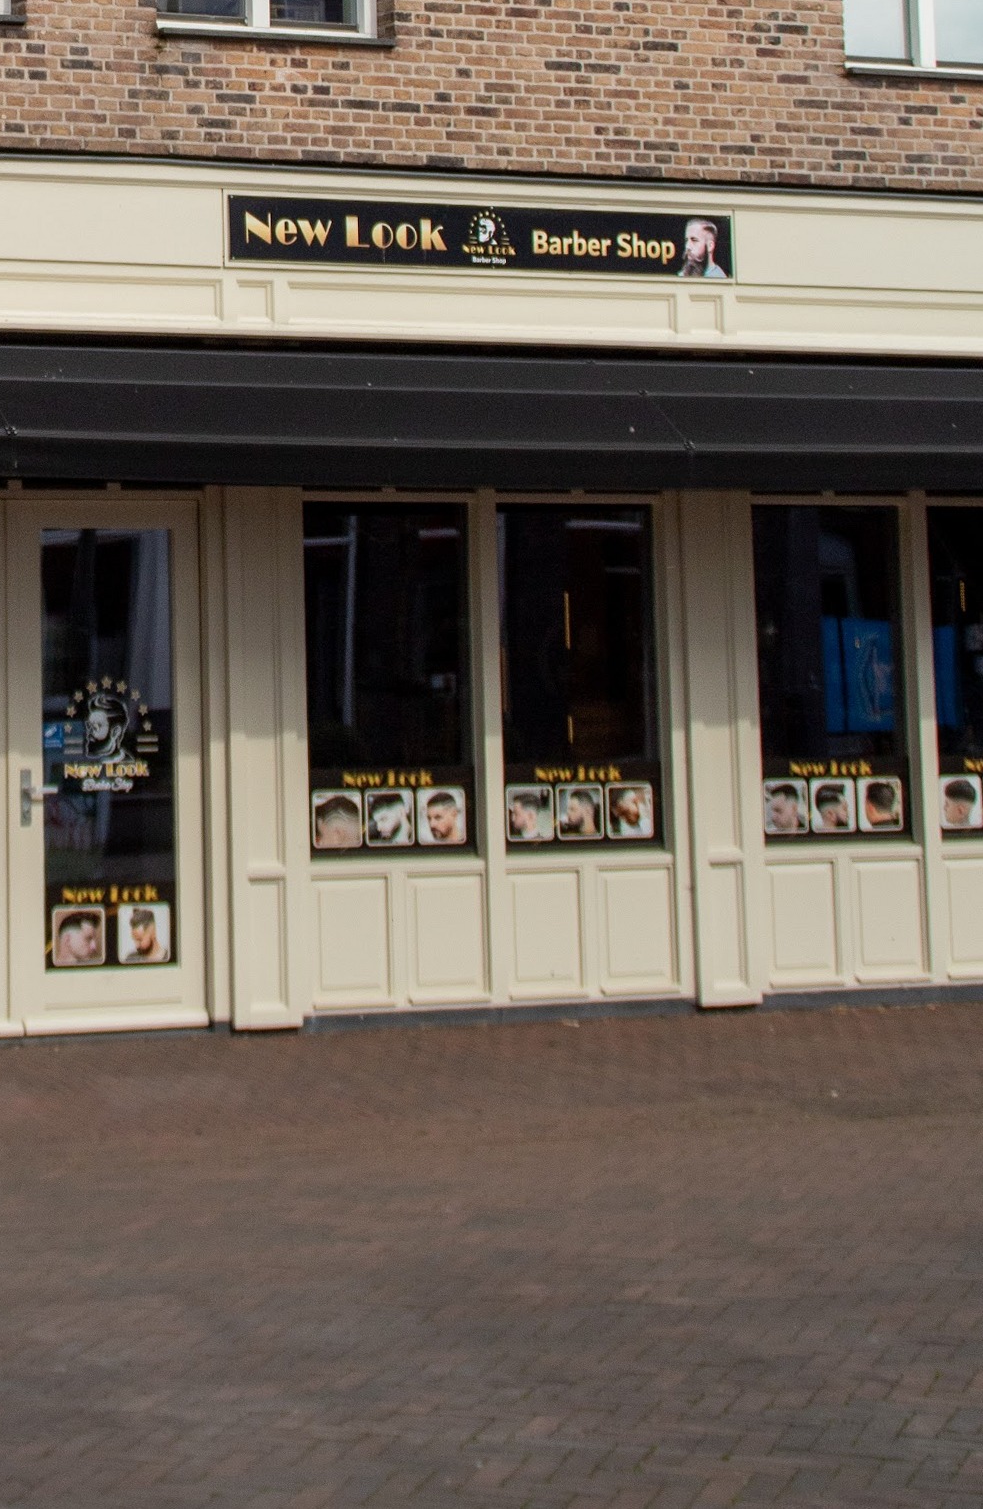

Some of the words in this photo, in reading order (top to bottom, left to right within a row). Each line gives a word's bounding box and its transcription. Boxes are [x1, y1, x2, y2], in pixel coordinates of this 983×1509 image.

[245, 210, 332, 247] New
[345, 215, 448, 251] Look
[462, 244, 485, 254] New
[488, 245, 516, 256] Look
[532, 228, 612, 257] Barber
[617, 232, 676, 265] Shop
[472, 256, 491, 264] Barber
[492, 257, 507, 265] Shop
[64, 764, 102, 779] New
[105, 761, 149, 778] Look
[63, 886, 105, 903] New
